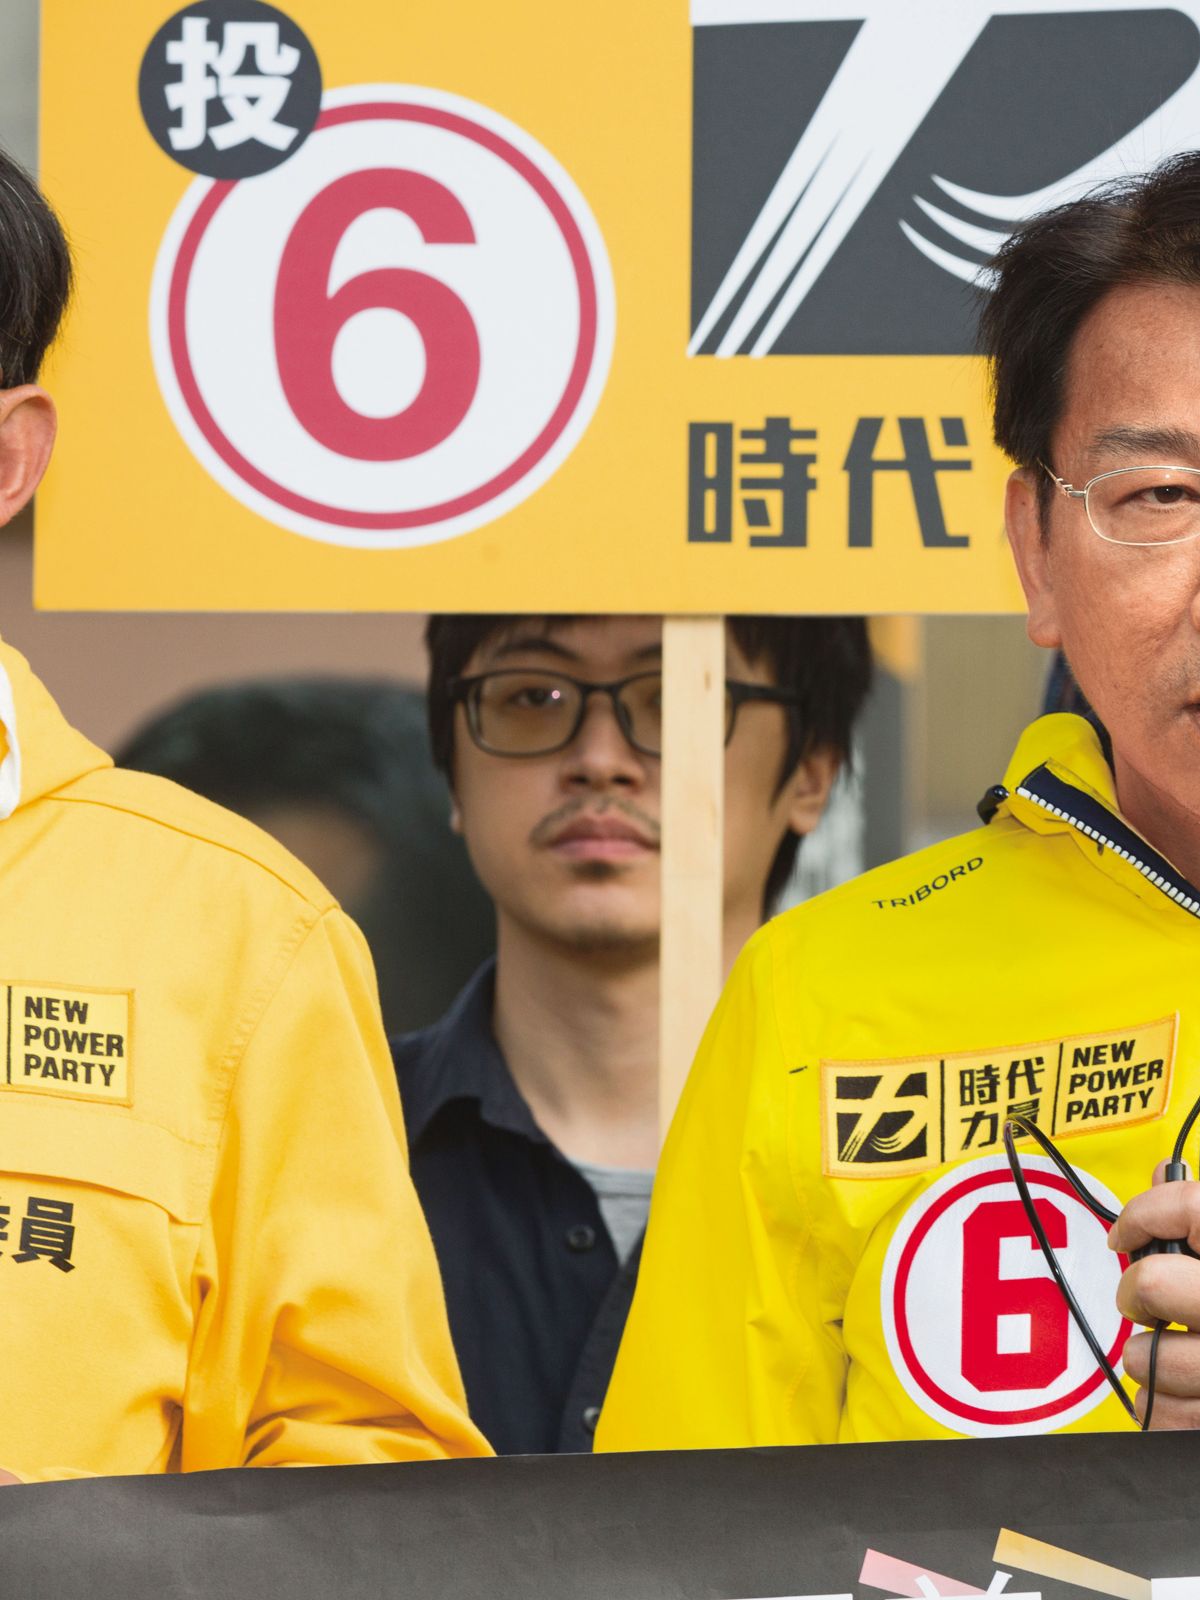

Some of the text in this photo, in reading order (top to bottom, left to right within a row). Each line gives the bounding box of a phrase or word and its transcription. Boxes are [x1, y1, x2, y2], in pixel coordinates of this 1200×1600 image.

[166, 17, 301, 152] 投
[272, 167, 481, 462] 6
[687, 416, 972, 548] 時代
[871, 857, 984, 909] TRIBORD
[24, 996, 88, 1024] NEW
[24, 1024, 124, 1057] POWER
[1072, 1039, 1136, 1068] NEW
[24, 1053, 115, 1087] PARTY
[959, 1056, 1045, 1107] 時代
[1069, 1058, 1164, 1095] POWER
[1066, 1086, 1155, 1123] PARTY
[0, 1195, 76, 1273] 員
[961, 1197, 1070, 1393] 6
